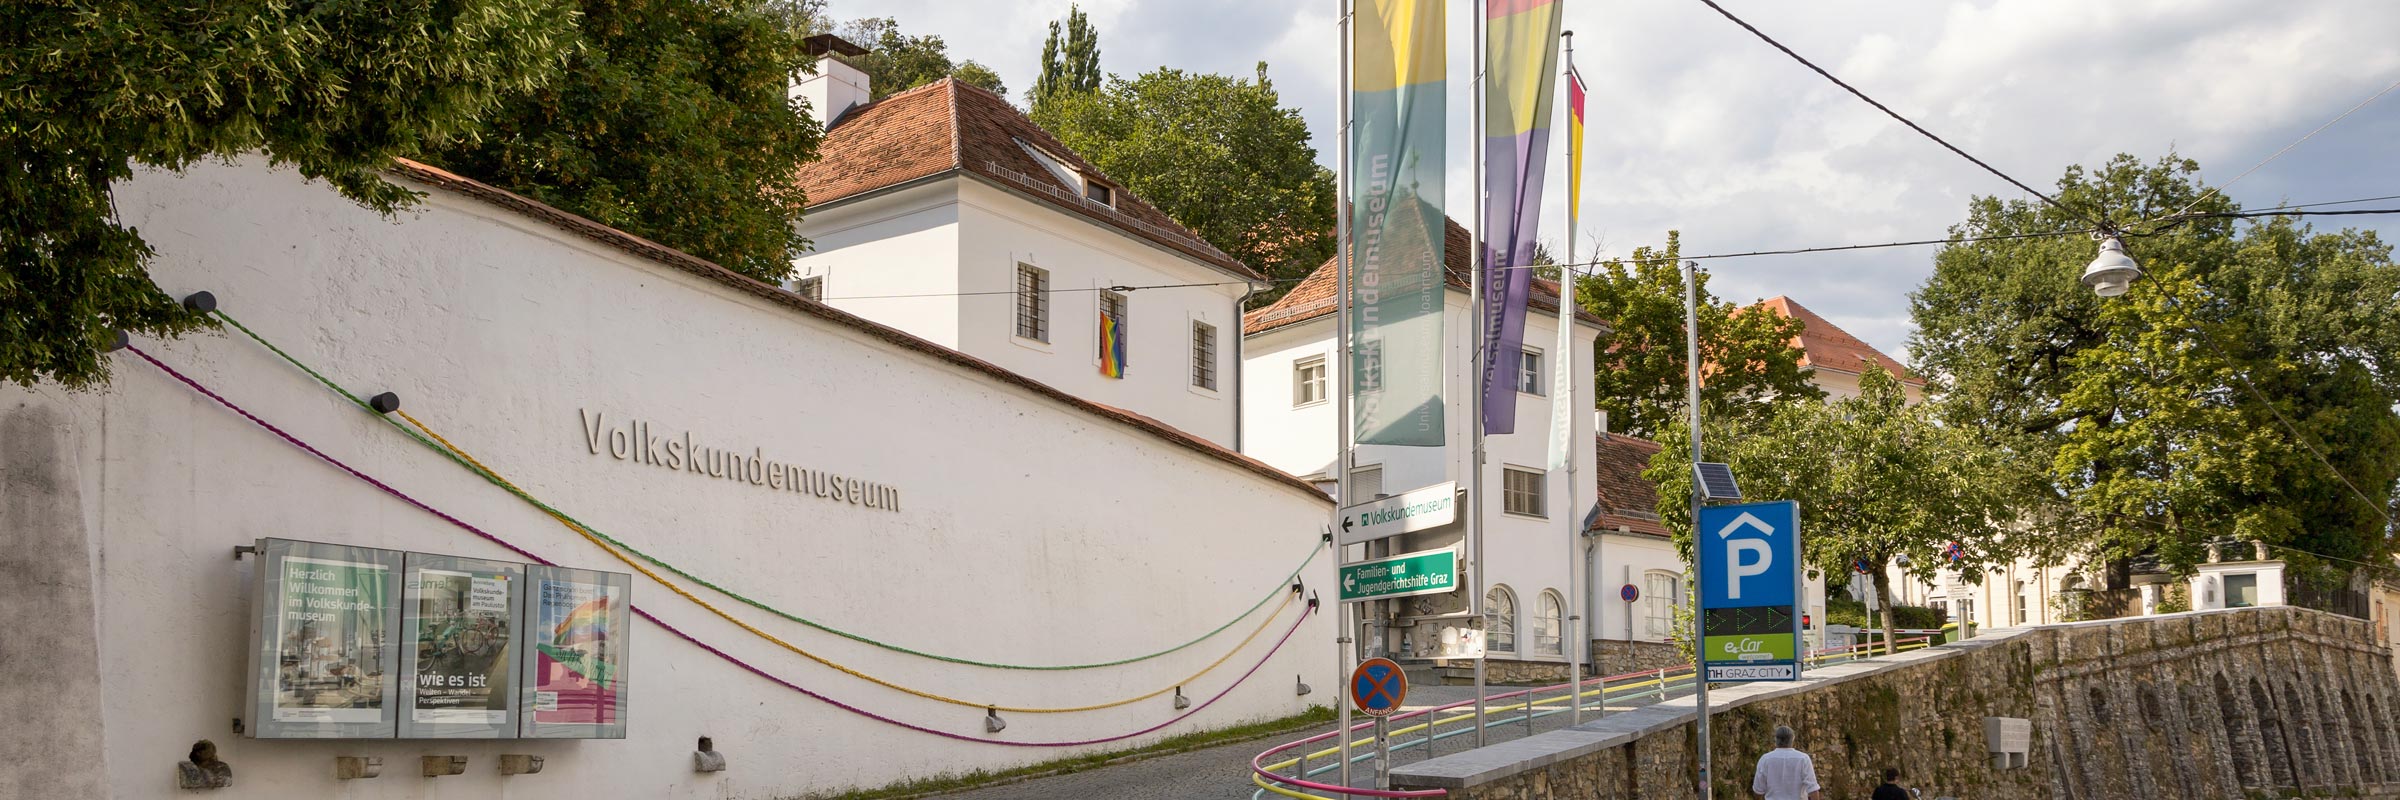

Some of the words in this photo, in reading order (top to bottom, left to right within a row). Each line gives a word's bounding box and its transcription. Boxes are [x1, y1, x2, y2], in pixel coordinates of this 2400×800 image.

[1419, 250, 1432, 315] Joanneum
[1484, 248, 1507, 424] ersalmuseum
[578, 407, 901, 513] Volkskundemuseum
[1370, 497, 1451, 526] Volkskundemuseum
[289, 567, 336, 581] Herzlich
[1357, 565, 1390, 580] Familien-
[1391, 562, 1406, 575] und
[1726, 538, 1773, 600] P
[289, 582, 359, 597] Willkommen
[1357, 573, 1429, 596] Jugendgerichtshilfe
[1430, 572, 1448, 585] Graz
[288, 595, 303, 608] im
[306, 597, 377, 612] Volkskunde-
[288, 611, 336, 622] museum
[420, 670, 445, 686] wie
[448, 675, 465, 687] es
[468, 672, 487, 687] ist
[1726, 668, 1756, 679] GRAZ
[1758, 667, 1784, 678] CITY
[418, 696, 460, 706] Perspektiven
[1365, 706, 1393, 716] ANFANG
